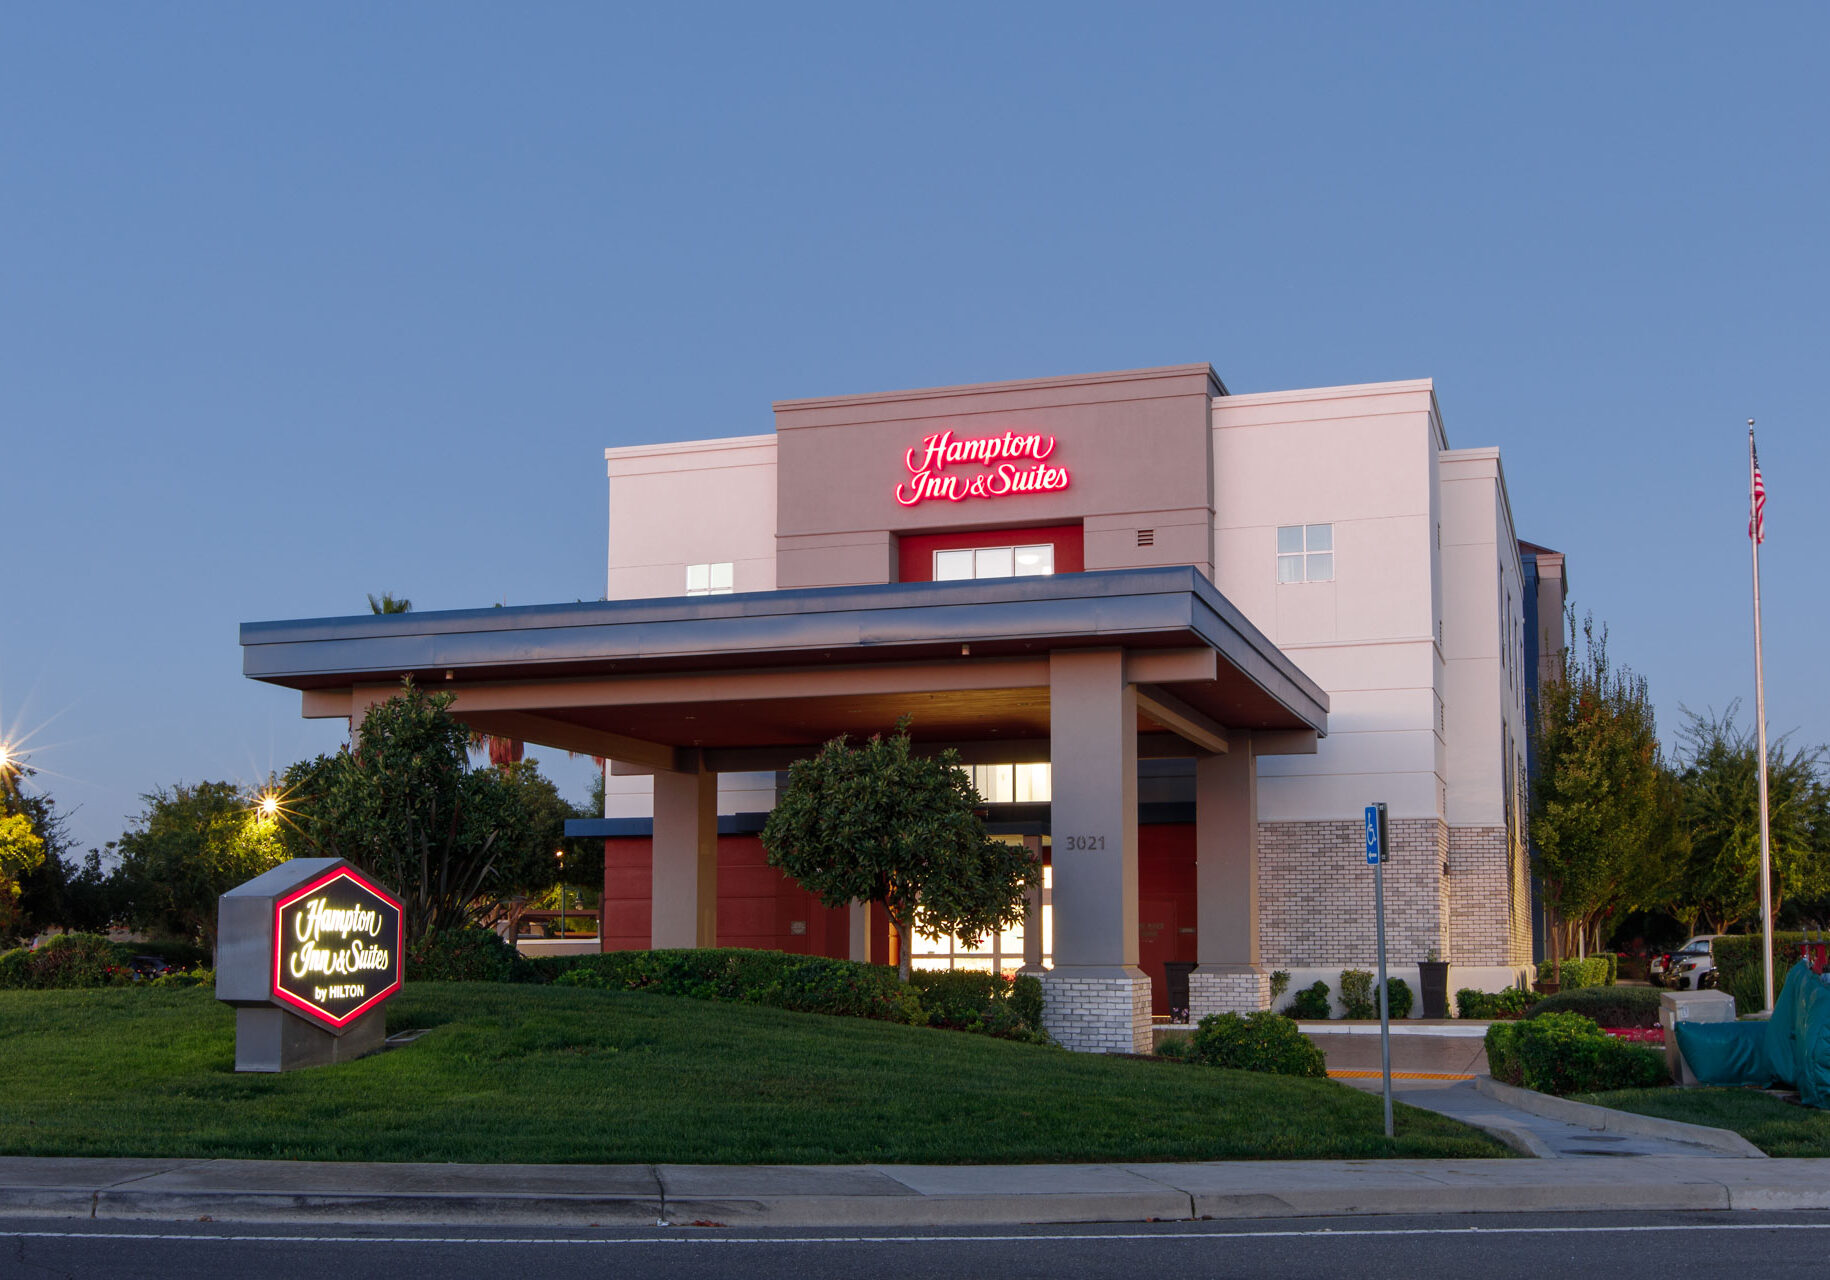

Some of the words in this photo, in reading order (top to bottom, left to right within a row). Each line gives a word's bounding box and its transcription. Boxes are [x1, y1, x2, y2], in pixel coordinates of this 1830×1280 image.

[906, 431, 1054, 473] Hampton
[896, 470, 970, 505] Inn
[970, 474, 991, 498] &
[987, 463, 1068, 495] Suites
[1066, 836, 1105, 850] 3021
[295, 898, 382, 942] Hampton
[290, 941, 337, 978] Inn
[336, 949, 347, 975] &
[346, 940, 389, 972] Suites
[315, 986, 327, 1002] by
[329, 984, 364, 999] HILTON
